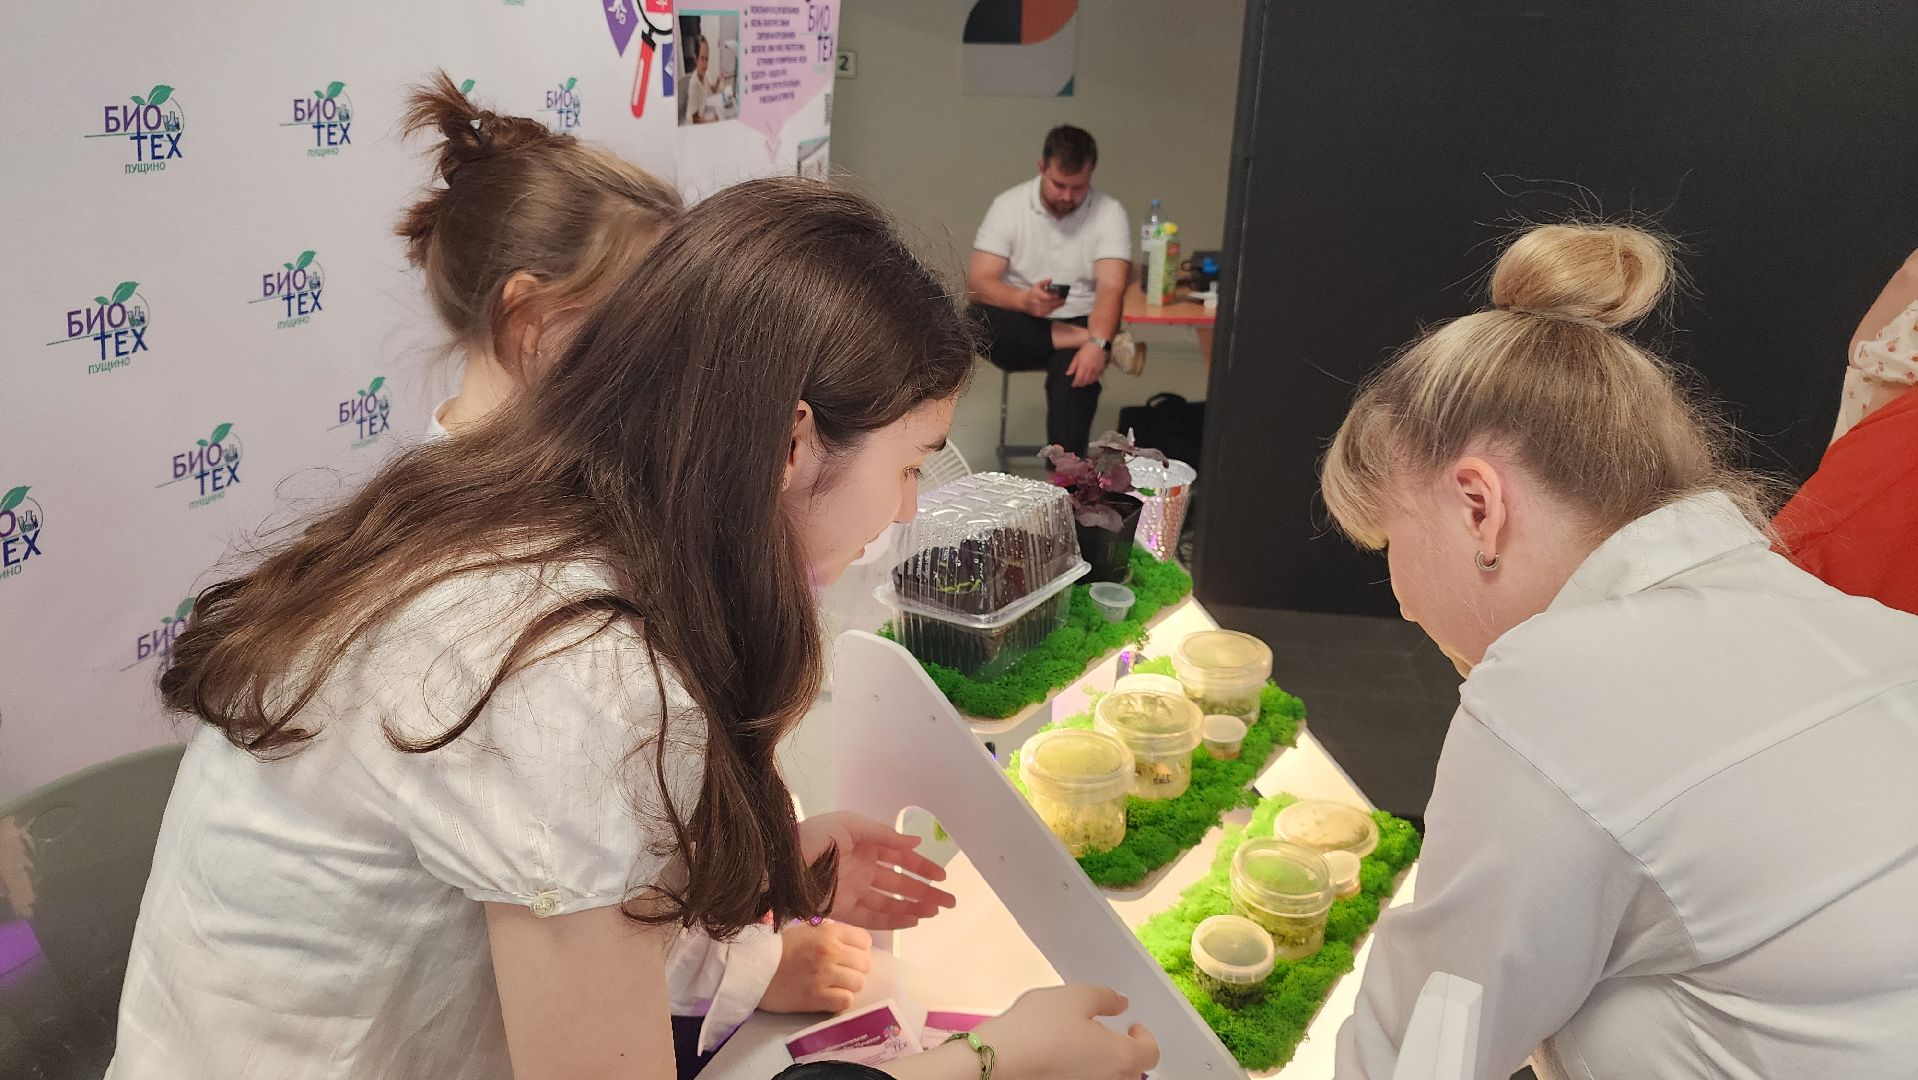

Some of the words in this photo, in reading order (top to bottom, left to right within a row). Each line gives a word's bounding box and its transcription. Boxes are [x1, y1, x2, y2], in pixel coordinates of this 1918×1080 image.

[294, 98, 336, 122] БИО
[547, 90, 573, 108] БИО
[104, 104, 162, 133] БИО
[557, 110, 580, 128] ТЕХ
[130, 133, 182, 161] ТЕХ
[312, 123, 351, 146] ТЕХ
[125, 162, 166, 174] ПУЩИНО
[263, 268, 307, 297] БИО
[282, 290, 323, 317] ТЕХ
[67, 302, 126, 338] БИО
[94, 327, 149, 360] ТЕХ
[88, 357, 131, 374] ПУЩИНО
[339, 394, 377, 424] БИО
[356, 411, 390, 439] ТЕХ
[173, 442, 222, 479] БИО
[195, 461, 240, 495] ТЕХ
[2, 529, 42, 568] ЕХ
[0, 565, 22, 579] ИНО
